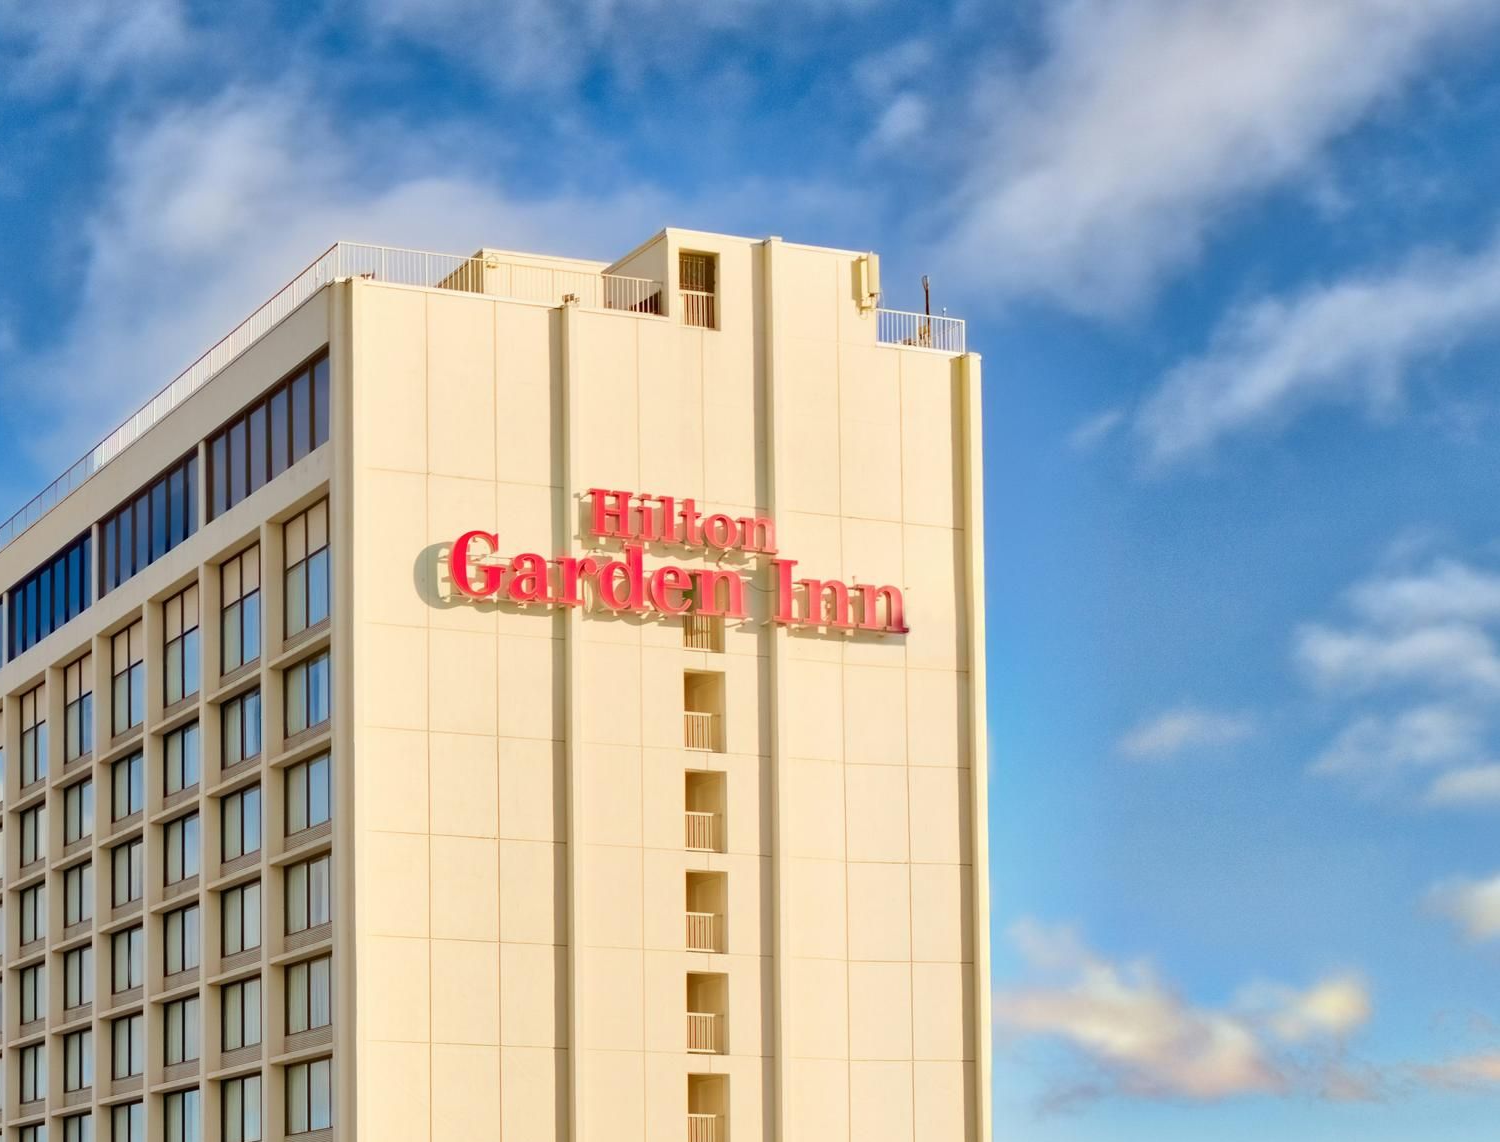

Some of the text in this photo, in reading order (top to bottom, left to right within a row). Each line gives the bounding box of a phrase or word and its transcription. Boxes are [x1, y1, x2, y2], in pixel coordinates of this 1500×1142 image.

[588, 487, 778, 555] Hilton
[448, 530, 909, 634] Garden Inn
